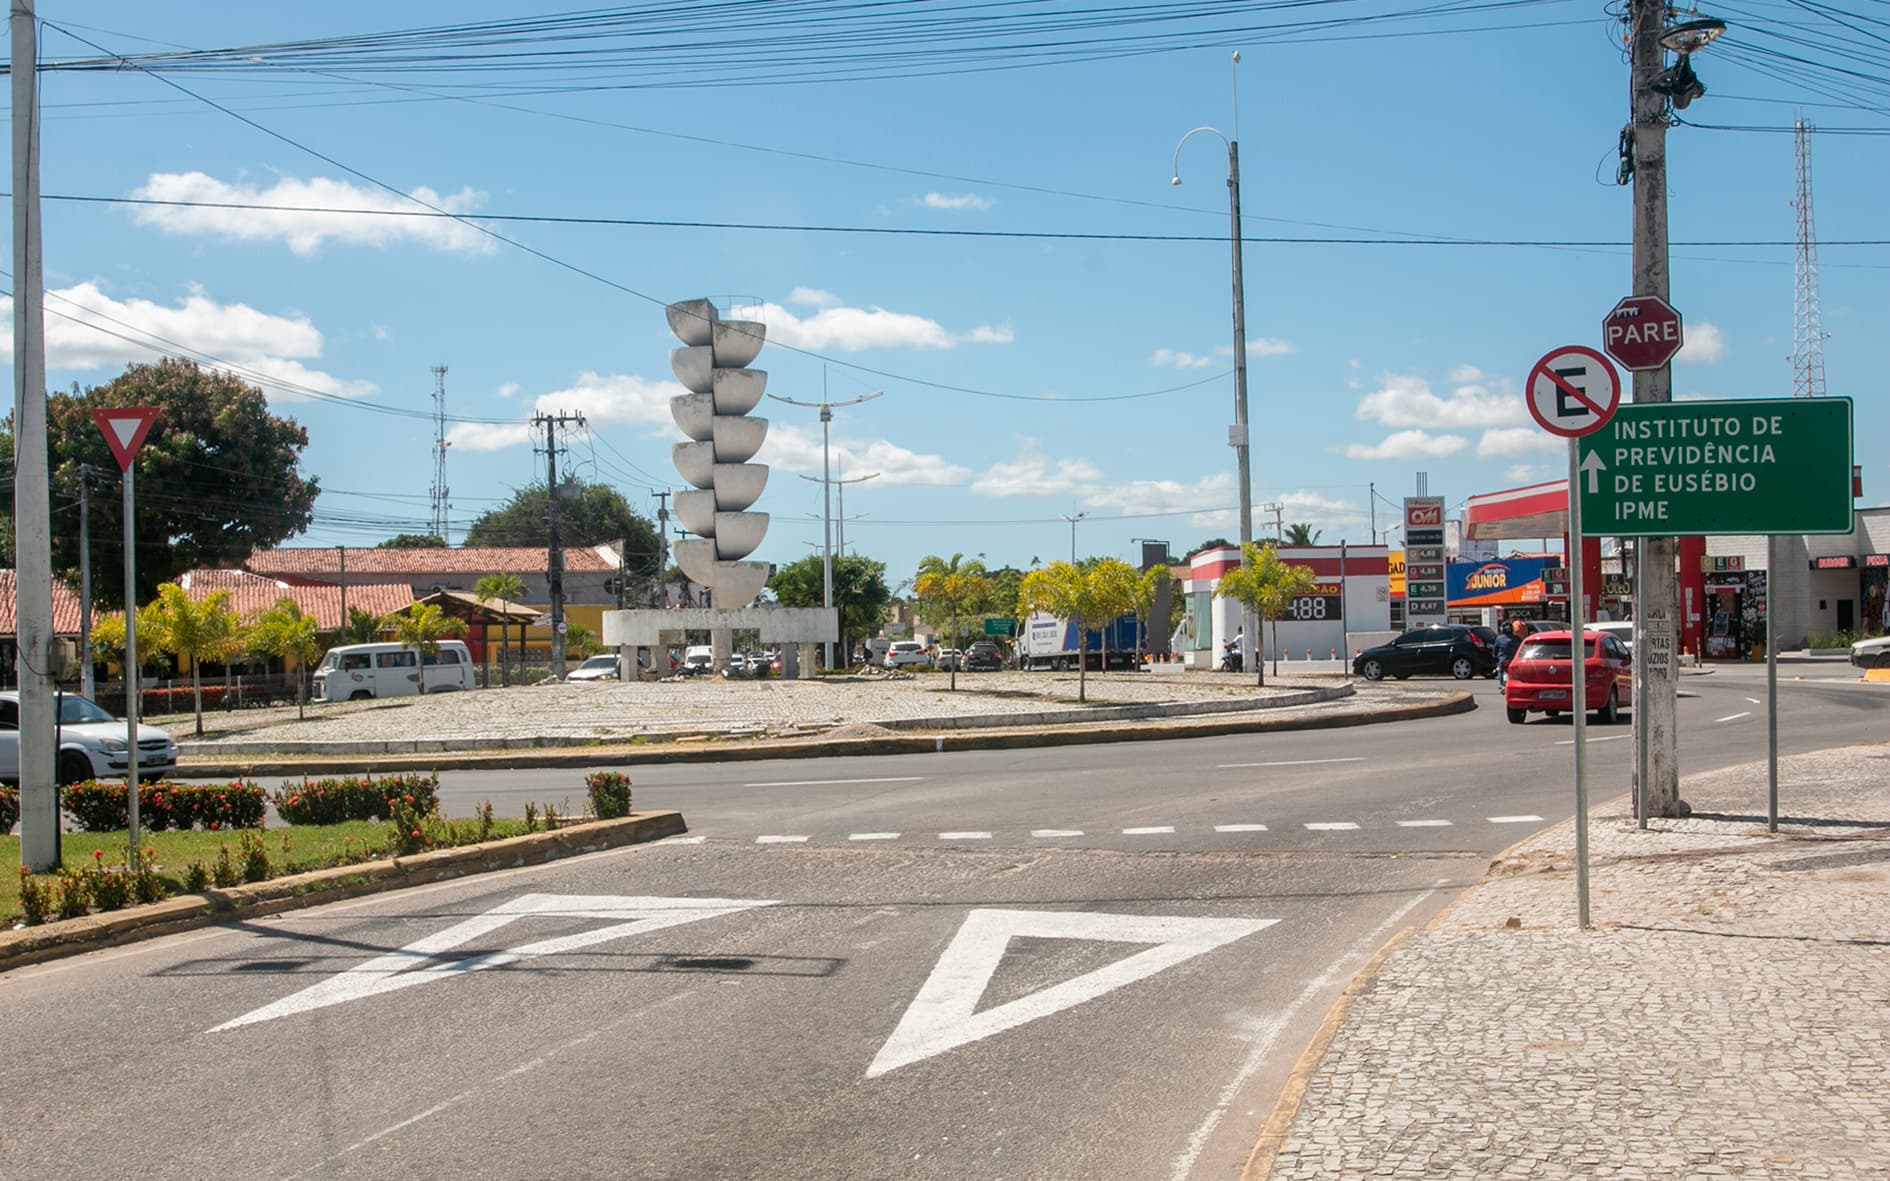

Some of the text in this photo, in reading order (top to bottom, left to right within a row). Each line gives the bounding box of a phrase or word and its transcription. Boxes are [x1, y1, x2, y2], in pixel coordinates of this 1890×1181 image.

[1608, 320, 1678, 346] PARE
[1555, 367, 1589, 417] E
[1614, 415, 1783, 440] INSTITUTO DE
[1615, 441, 1776, 466] PREVIDÊNCIA
[1615, 469, 1756, 493] DE EUSÉBIO
[1615, 500, 1669, 520] IPME
[1717, 558, 1724, 566] E
[1730, 557, 1738, 566] G
[1410, 584, 1417, 593] E
[1471, 573, 1506, 589] JUNIOR
